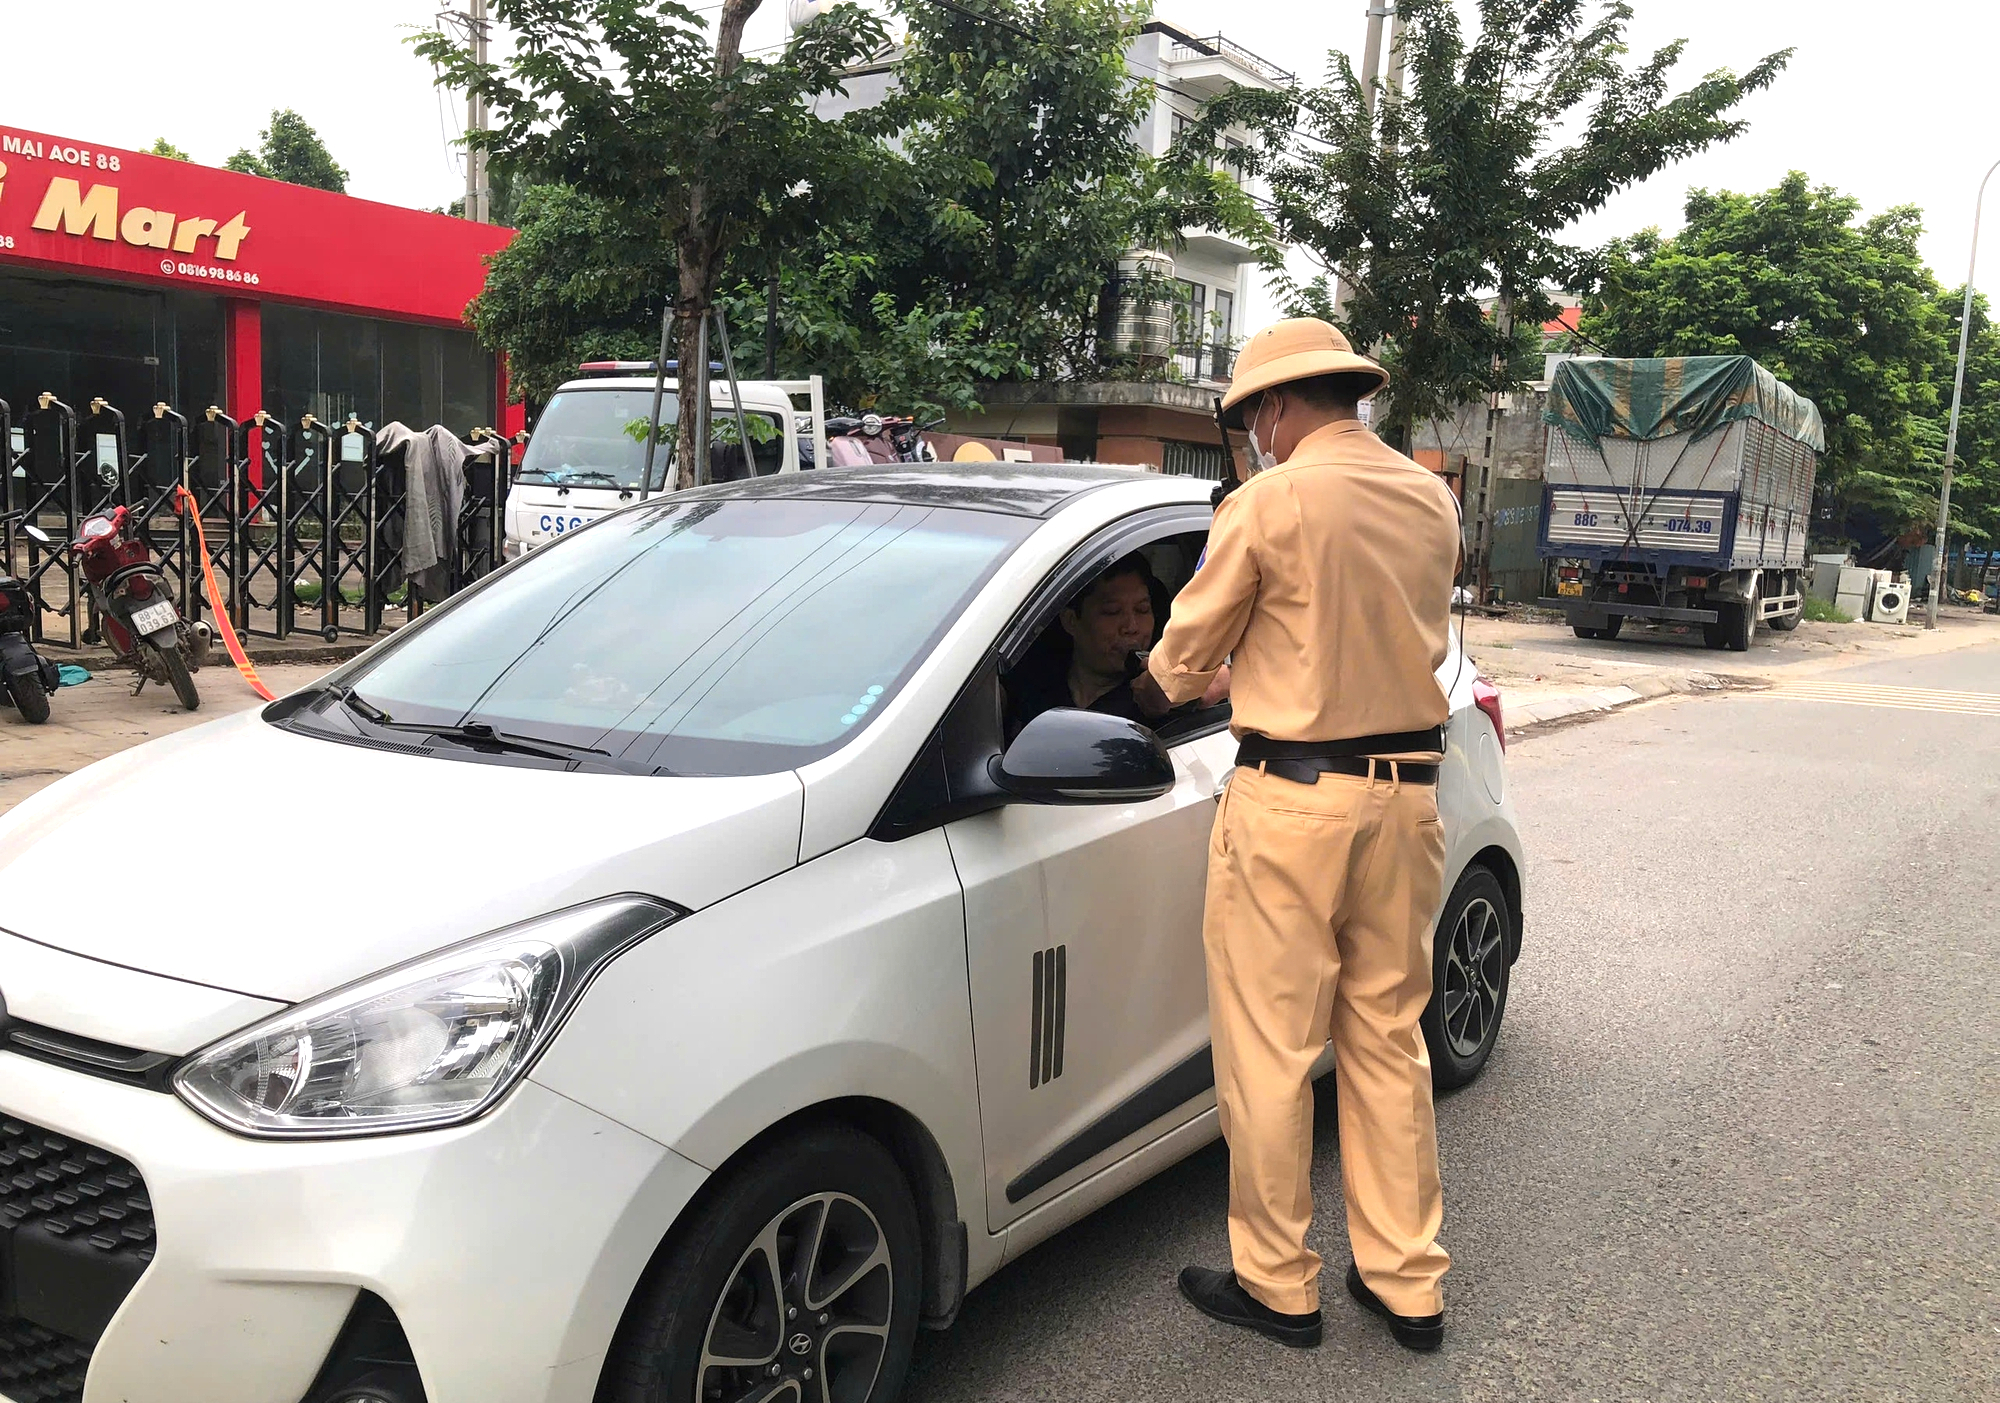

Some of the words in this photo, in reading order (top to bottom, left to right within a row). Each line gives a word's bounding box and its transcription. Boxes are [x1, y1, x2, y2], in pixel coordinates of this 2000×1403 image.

[3, 135, 43, 161] MẠI
[49, 145, 91, 167] AOE
[96, 153, 121, 172] 88
[31, 176, 251, 261] Mart
[540, 515, 595, 533] CSG
[1574, 513, 1598, 527] 88C
[138, 604, 167, 622] 88-L1
[140, 612, 175, 633] 039.63
